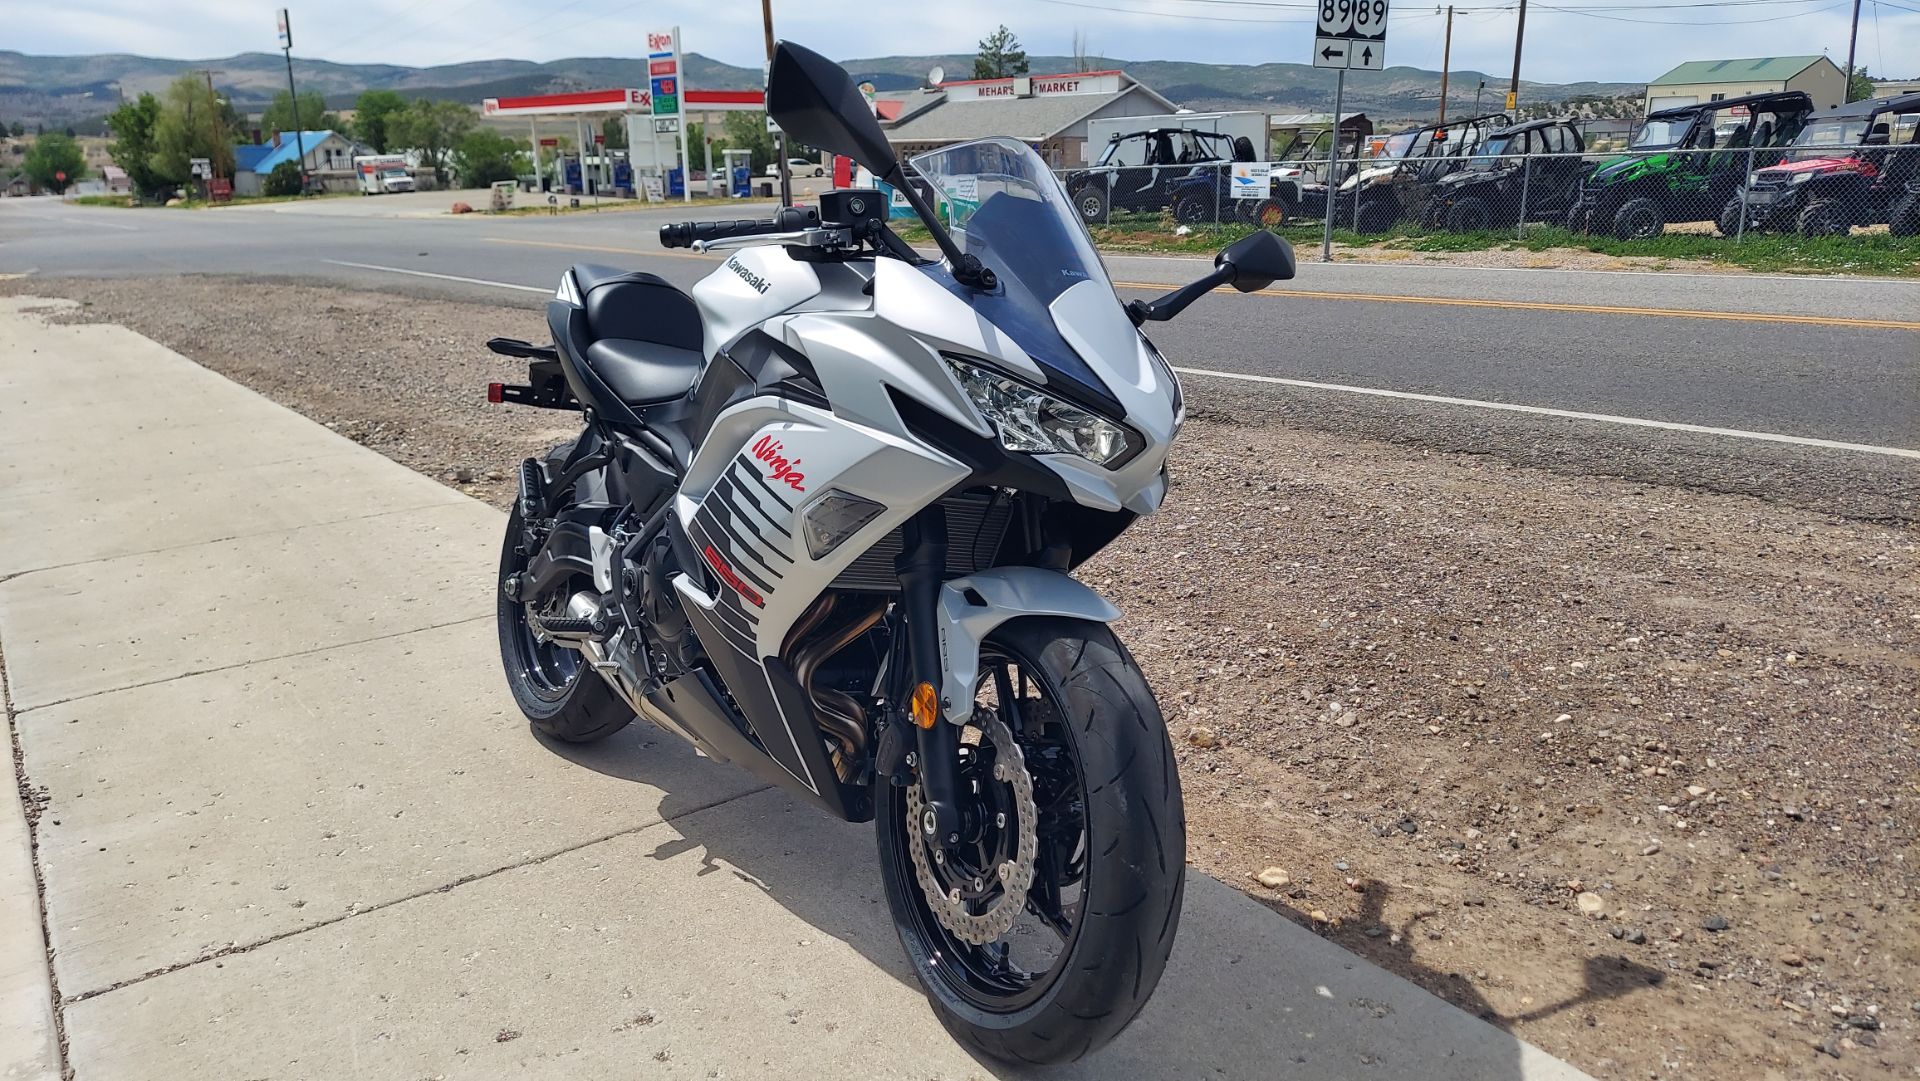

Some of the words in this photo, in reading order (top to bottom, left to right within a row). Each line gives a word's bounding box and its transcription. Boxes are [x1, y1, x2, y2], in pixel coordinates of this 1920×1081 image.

[1322, 0, 1350, 23] 89
[1357, 0, 1385, 26] 89
[648, 33, 672, 51] Exxon
[631, 90, 652, 106] Exx
[726, 255, 772, 295] Kawasaki
[1061, 268, 1088, 279] Kawa
[751, 434, 806, 493] Ninja
[704, 544, 765, 608] 650
